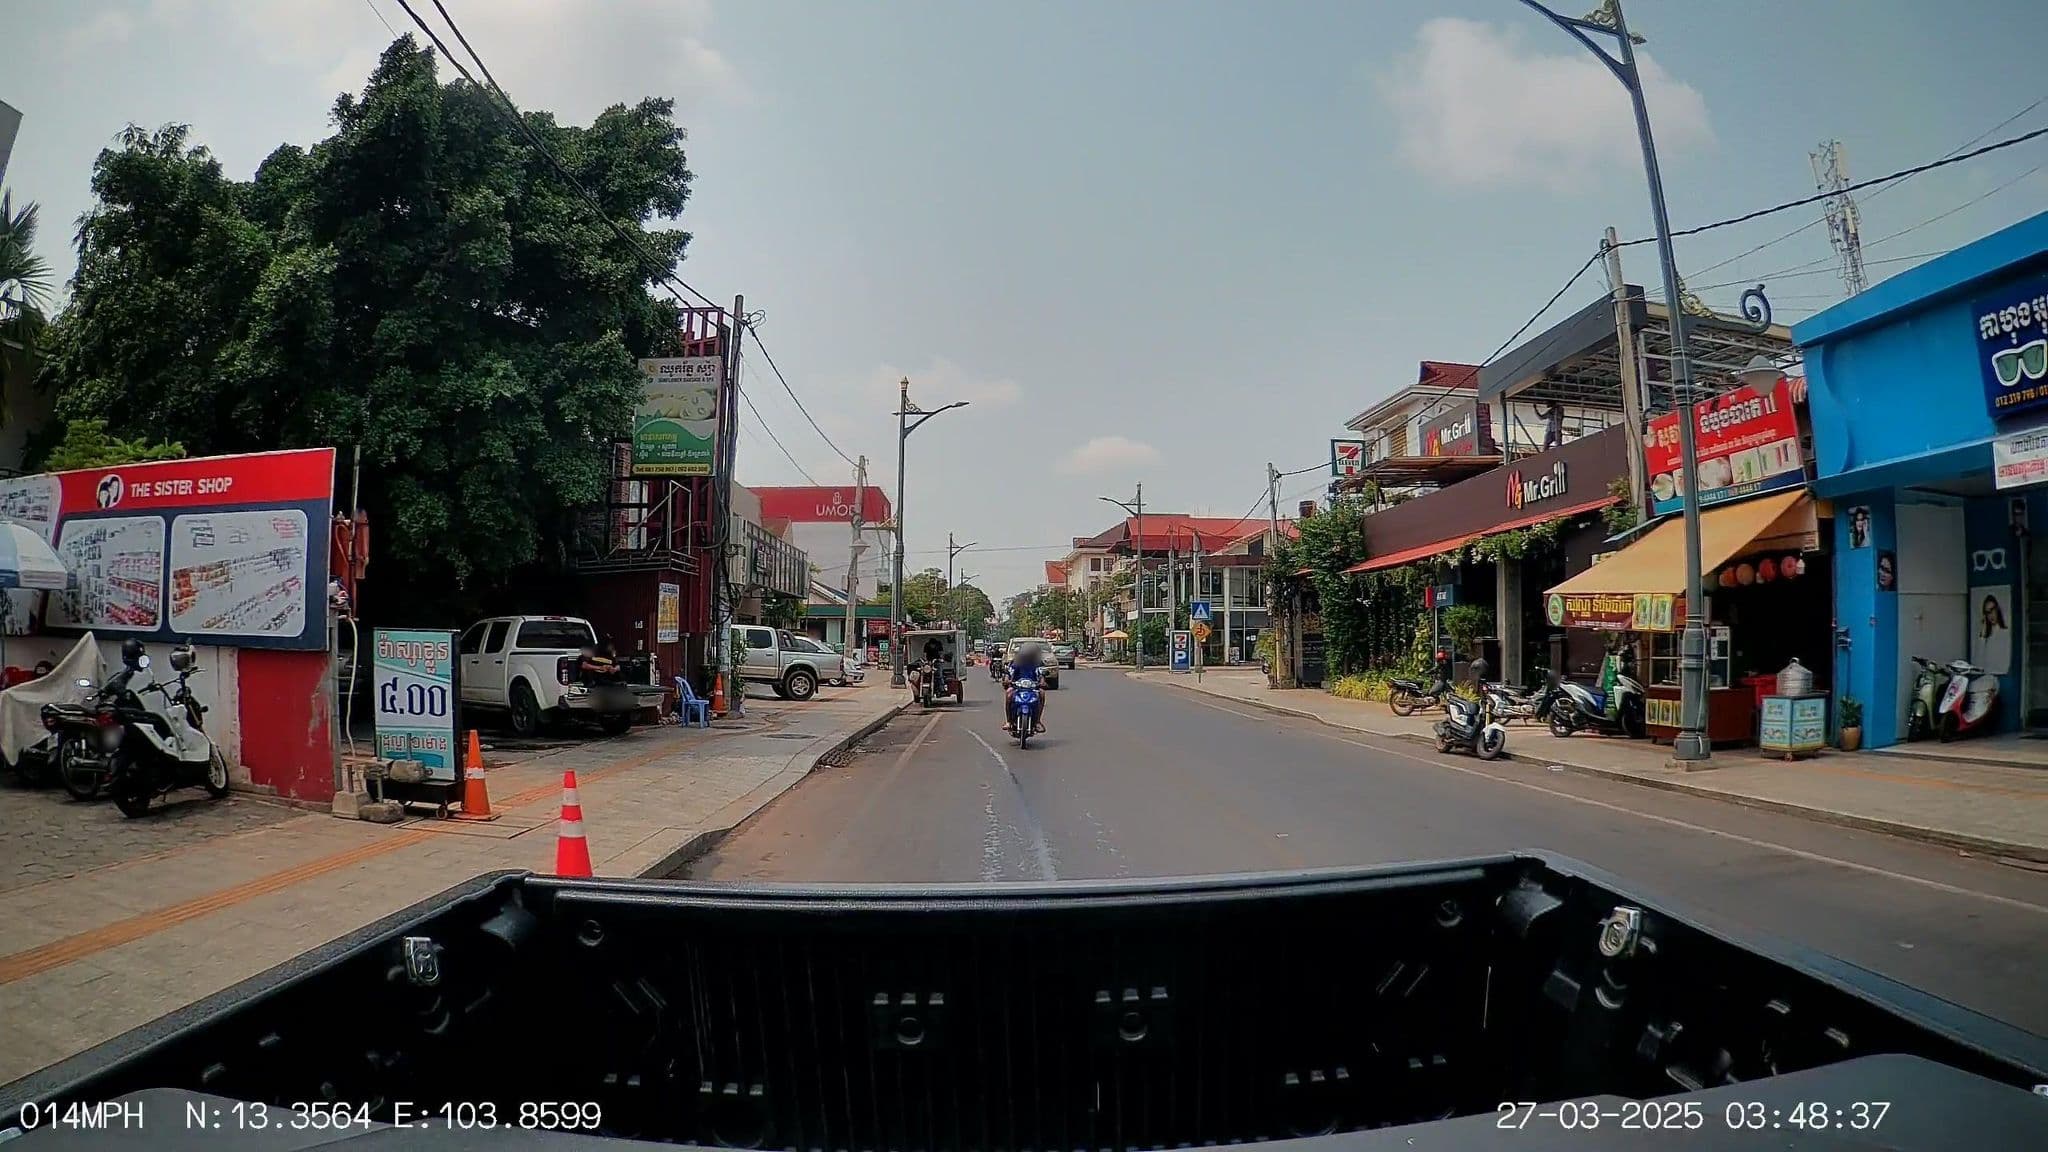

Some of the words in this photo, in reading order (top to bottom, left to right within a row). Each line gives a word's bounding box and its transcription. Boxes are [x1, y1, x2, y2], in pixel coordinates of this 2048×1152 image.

[131, 483, 151, 497] THE
[154, 480, 193, 497] SISTER
[197, 477, 233, 494] SHOP
[1523, 460, 1566, 503] Mr.Grill
[1174, 650, 1187, 663] P
